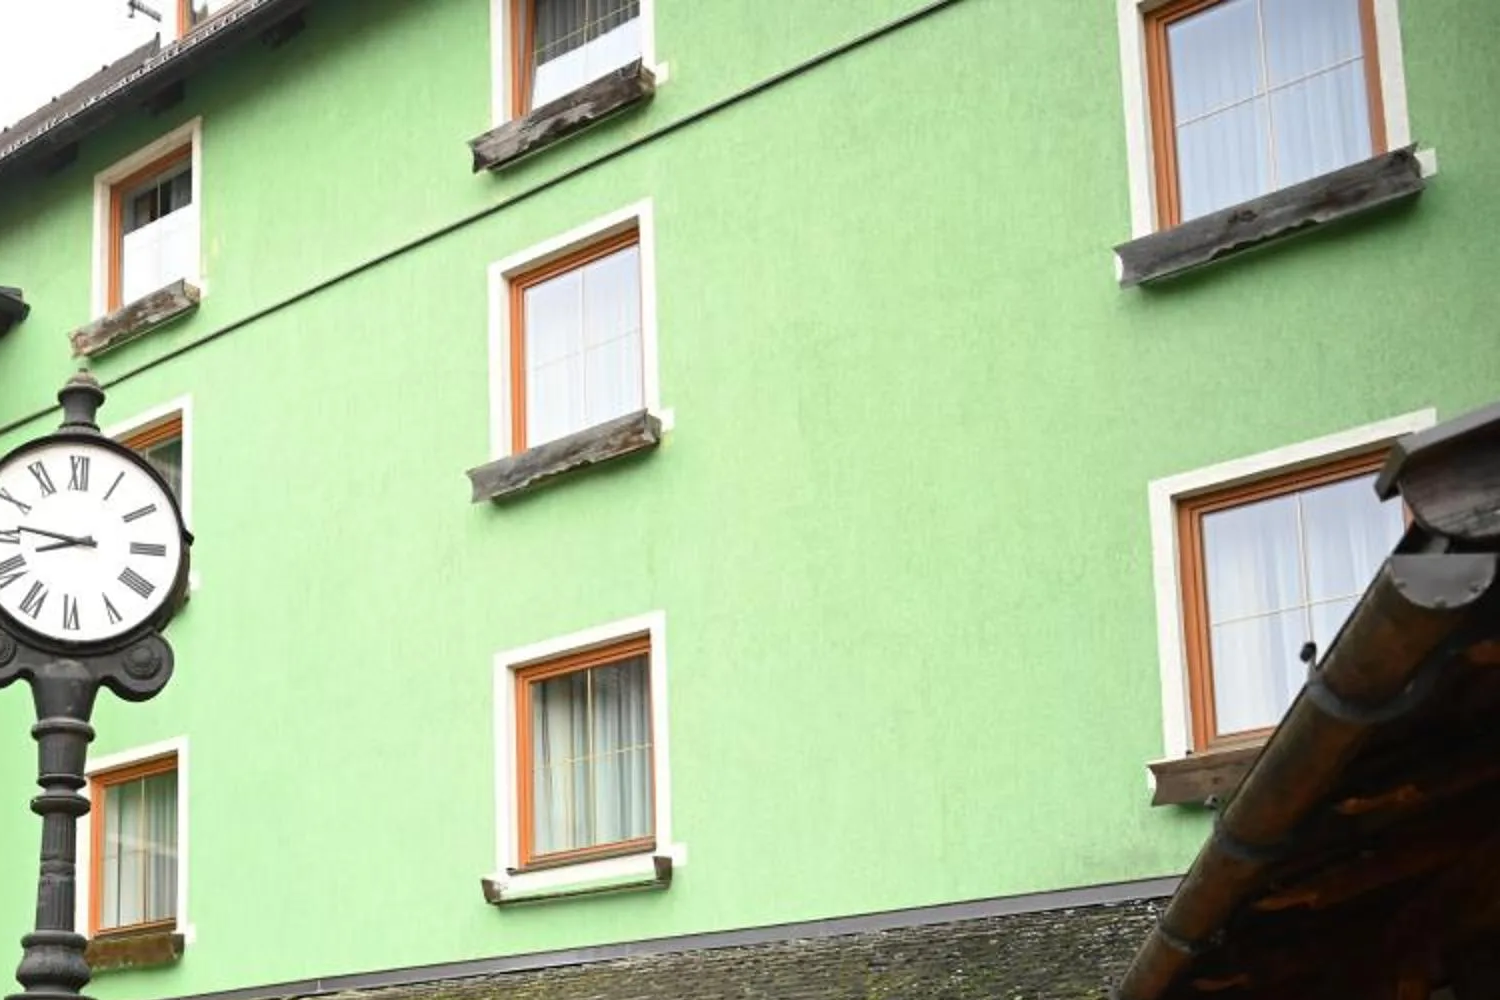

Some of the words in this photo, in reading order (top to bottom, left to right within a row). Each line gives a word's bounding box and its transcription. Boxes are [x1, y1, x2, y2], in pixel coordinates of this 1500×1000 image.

[27, 460, 57, 498] XI
[68, 455, 90, 492] XII
[103, 471, 125, 501] I
[122, 503, 157, 523] II
[130, 541, 167, 557] III
[18, 580, 49, 620] VII
[62, 594, 80, 631] VI
[102, 592, 123, 624] V
